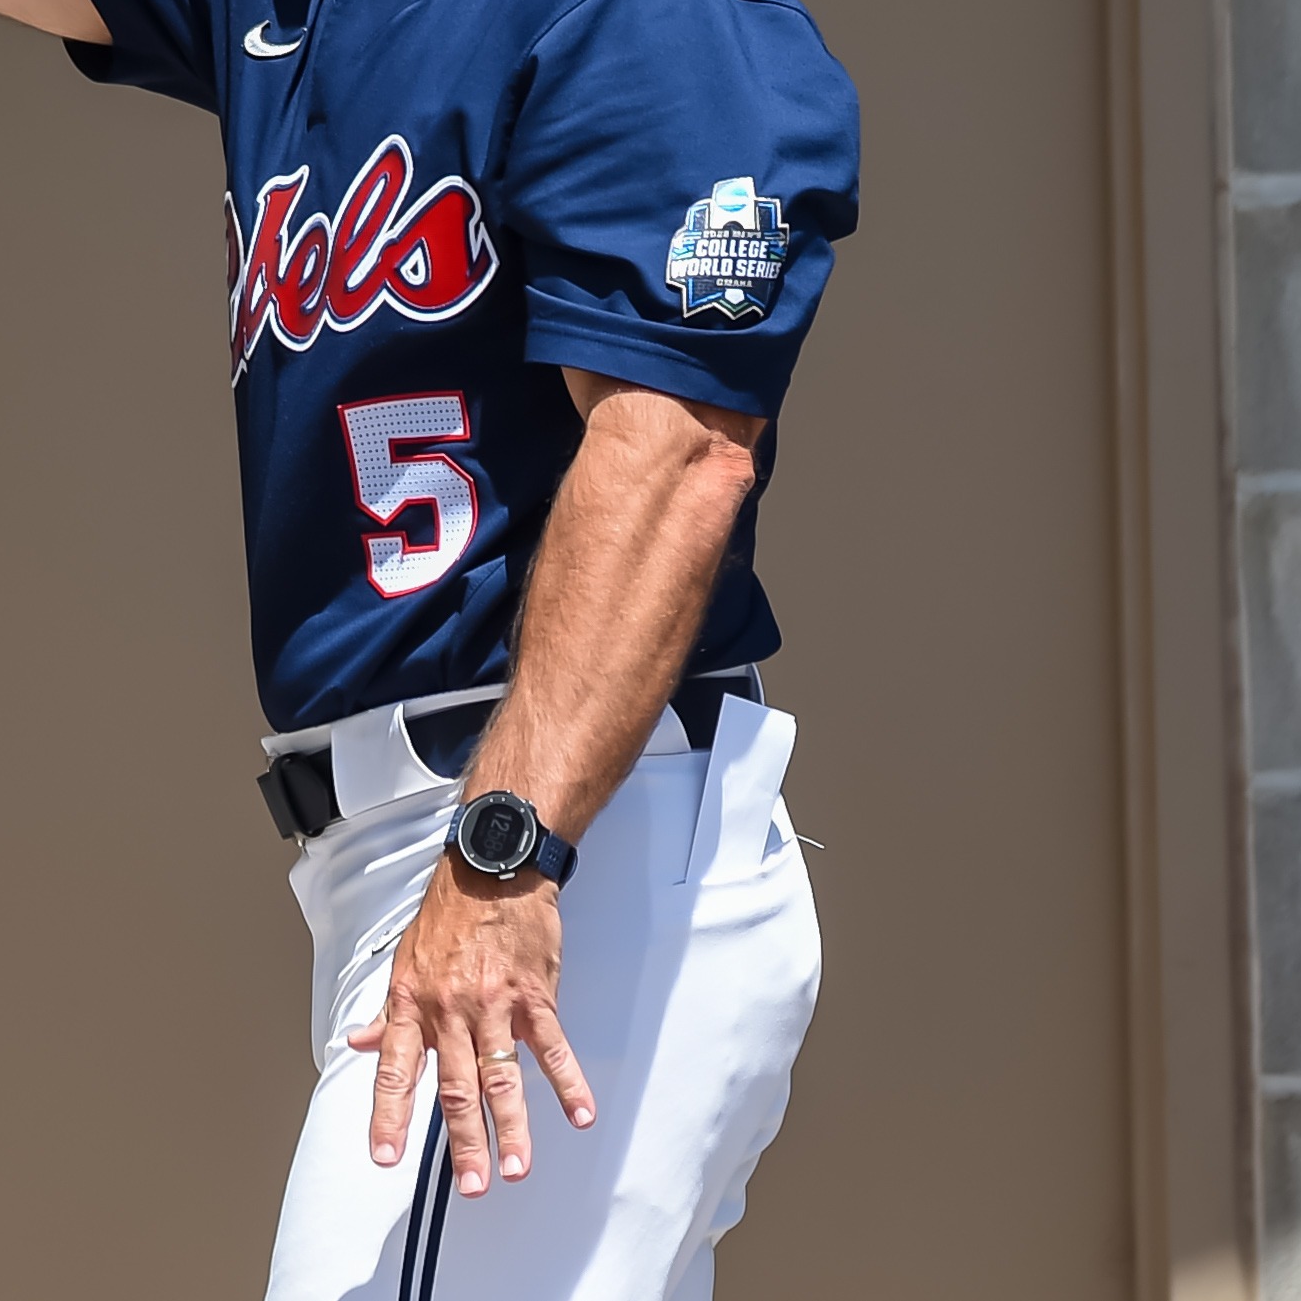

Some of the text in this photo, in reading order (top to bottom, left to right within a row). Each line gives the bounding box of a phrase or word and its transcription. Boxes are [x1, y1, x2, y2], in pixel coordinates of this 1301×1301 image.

[225, 134, 500, 388] bels
[670, 258, 782, 280] WORLD SERIES
[695, 239, 769, 259] COLLEGE
[337, 390, 479, 598] 5
